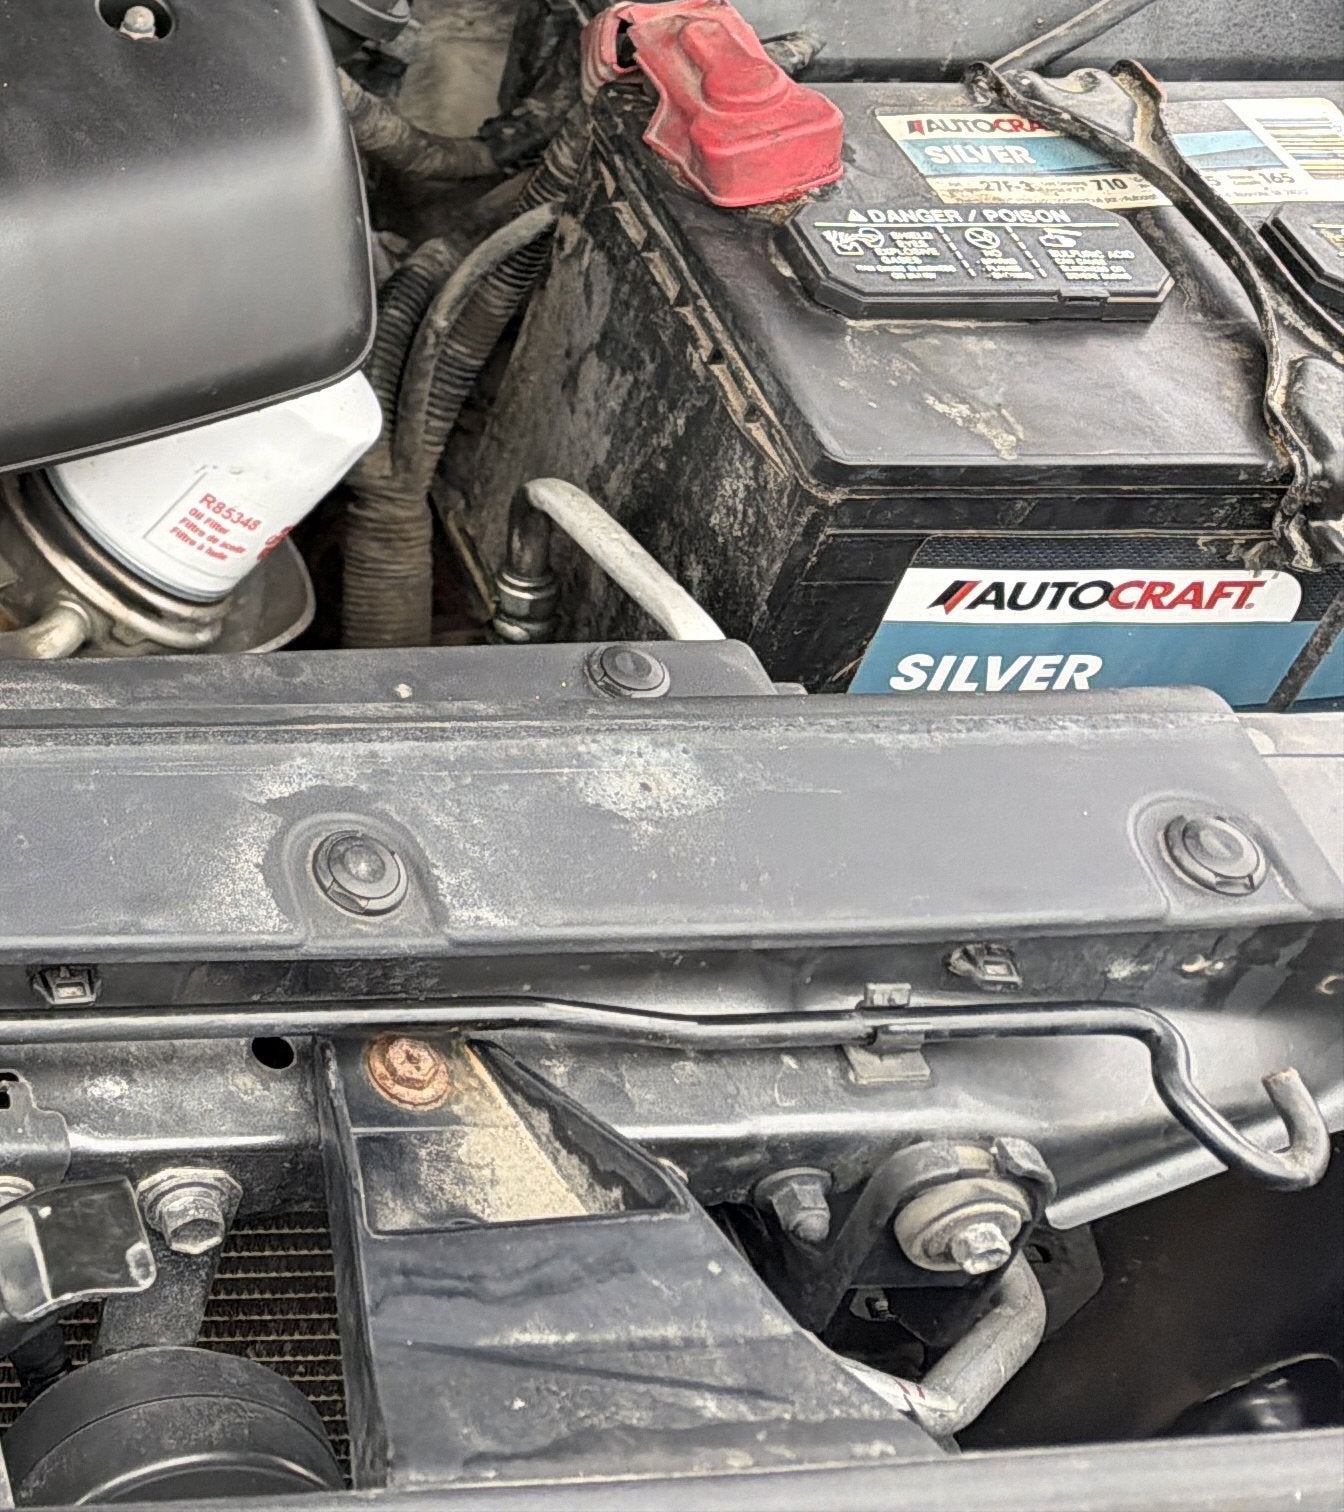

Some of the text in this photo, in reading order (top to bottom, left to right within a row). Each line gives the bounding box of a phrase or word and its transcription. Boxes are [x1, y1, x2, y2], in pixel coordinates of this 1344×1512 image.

[925, 118, 1051, 133] AUTOCRA
[924, 144, 1037, 165] SILVER
[1089, 177, 1129, 190] 710
[1258, 172, 1296, 185] 165
[866, 208, 965, 223] DANGER
[982, 208, 1072, 223] POISON
[888, 653, 1103, 692] SILVER
